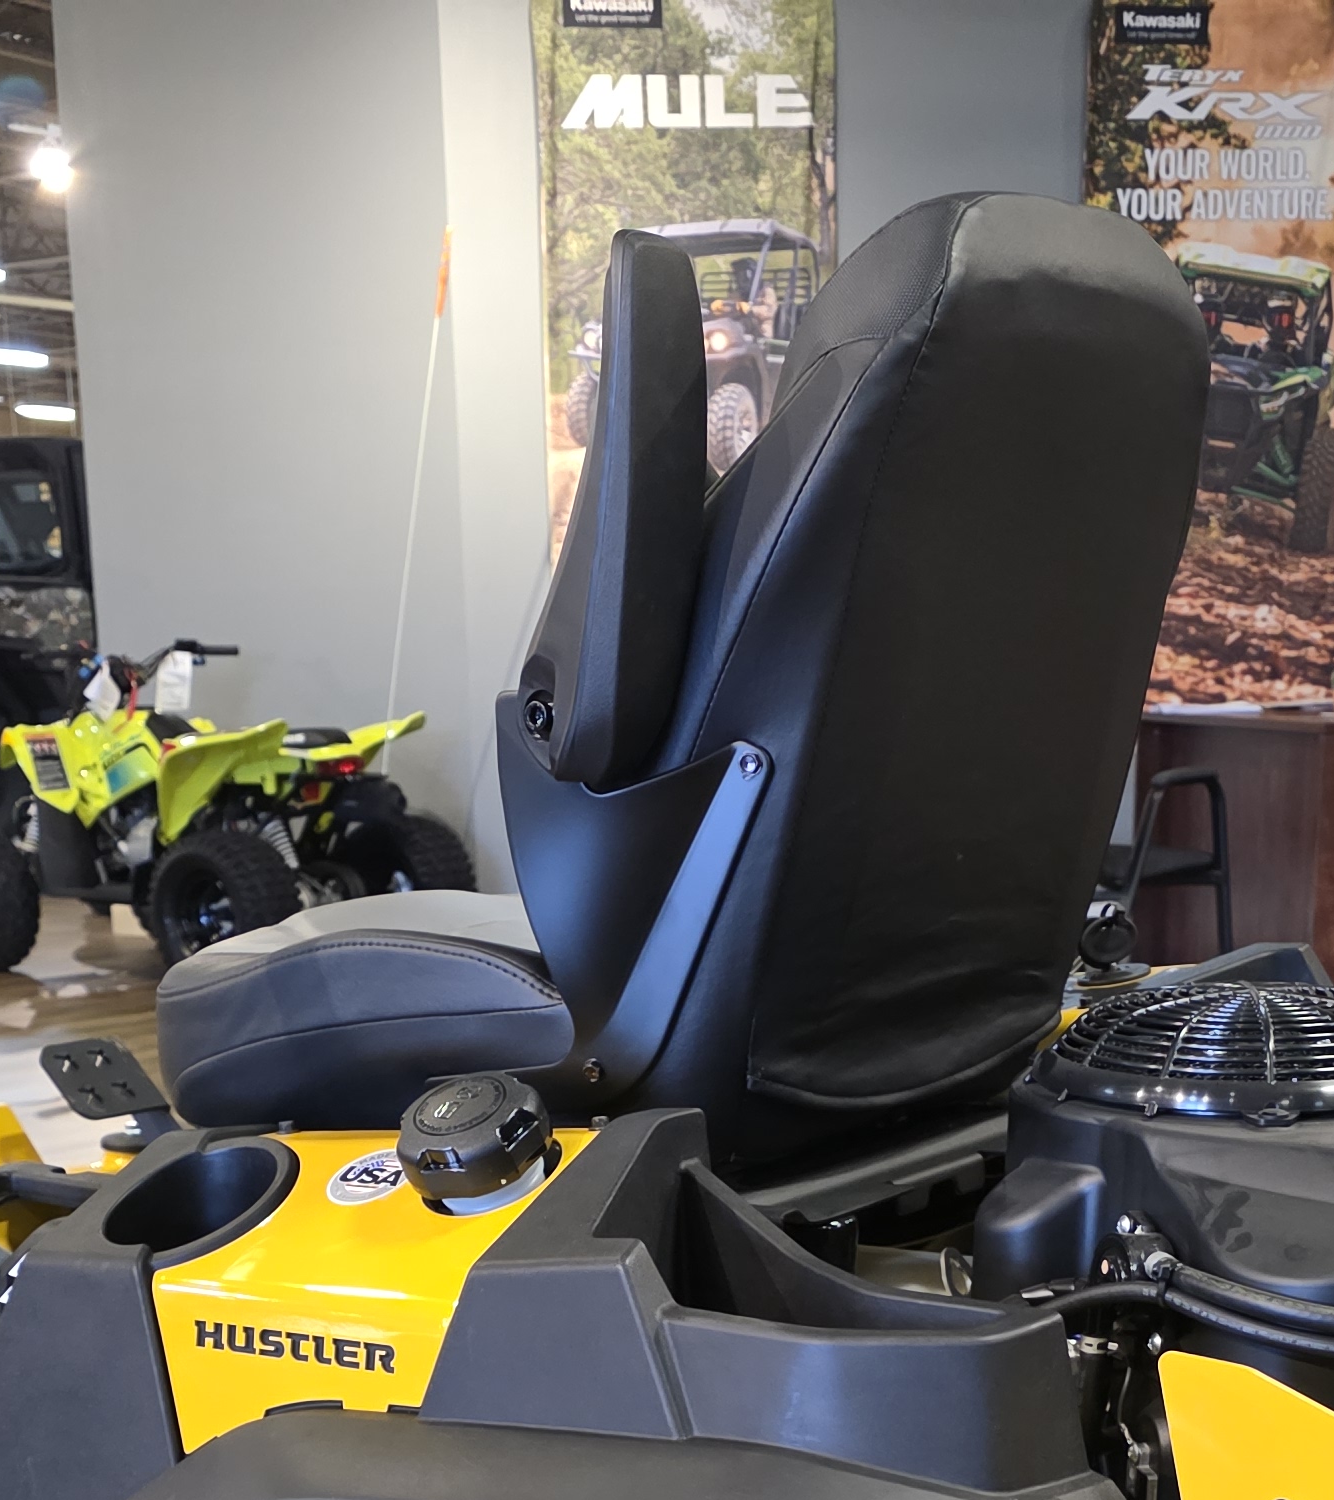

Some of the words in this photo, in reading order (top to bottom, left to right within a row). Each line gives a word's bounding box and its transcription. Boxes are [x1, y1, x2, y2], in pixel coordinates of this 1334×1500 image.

[1122, 10, 1201, 29] Kawasaki
[561, 74, 816, 129] MULE
[1125, 85, 1327, 120] KRX
[1144, 147, 1210, 181] YOUR
[1219, 149, 1310, 181] WORLD.
[1116, 187, 1183, 221] YOUR
[1190, 188, 1334, 221] ADVENTURE.
[339, 1166, 404, 1186] USA
[194, 1319, 396, 1374] HUSTLER
